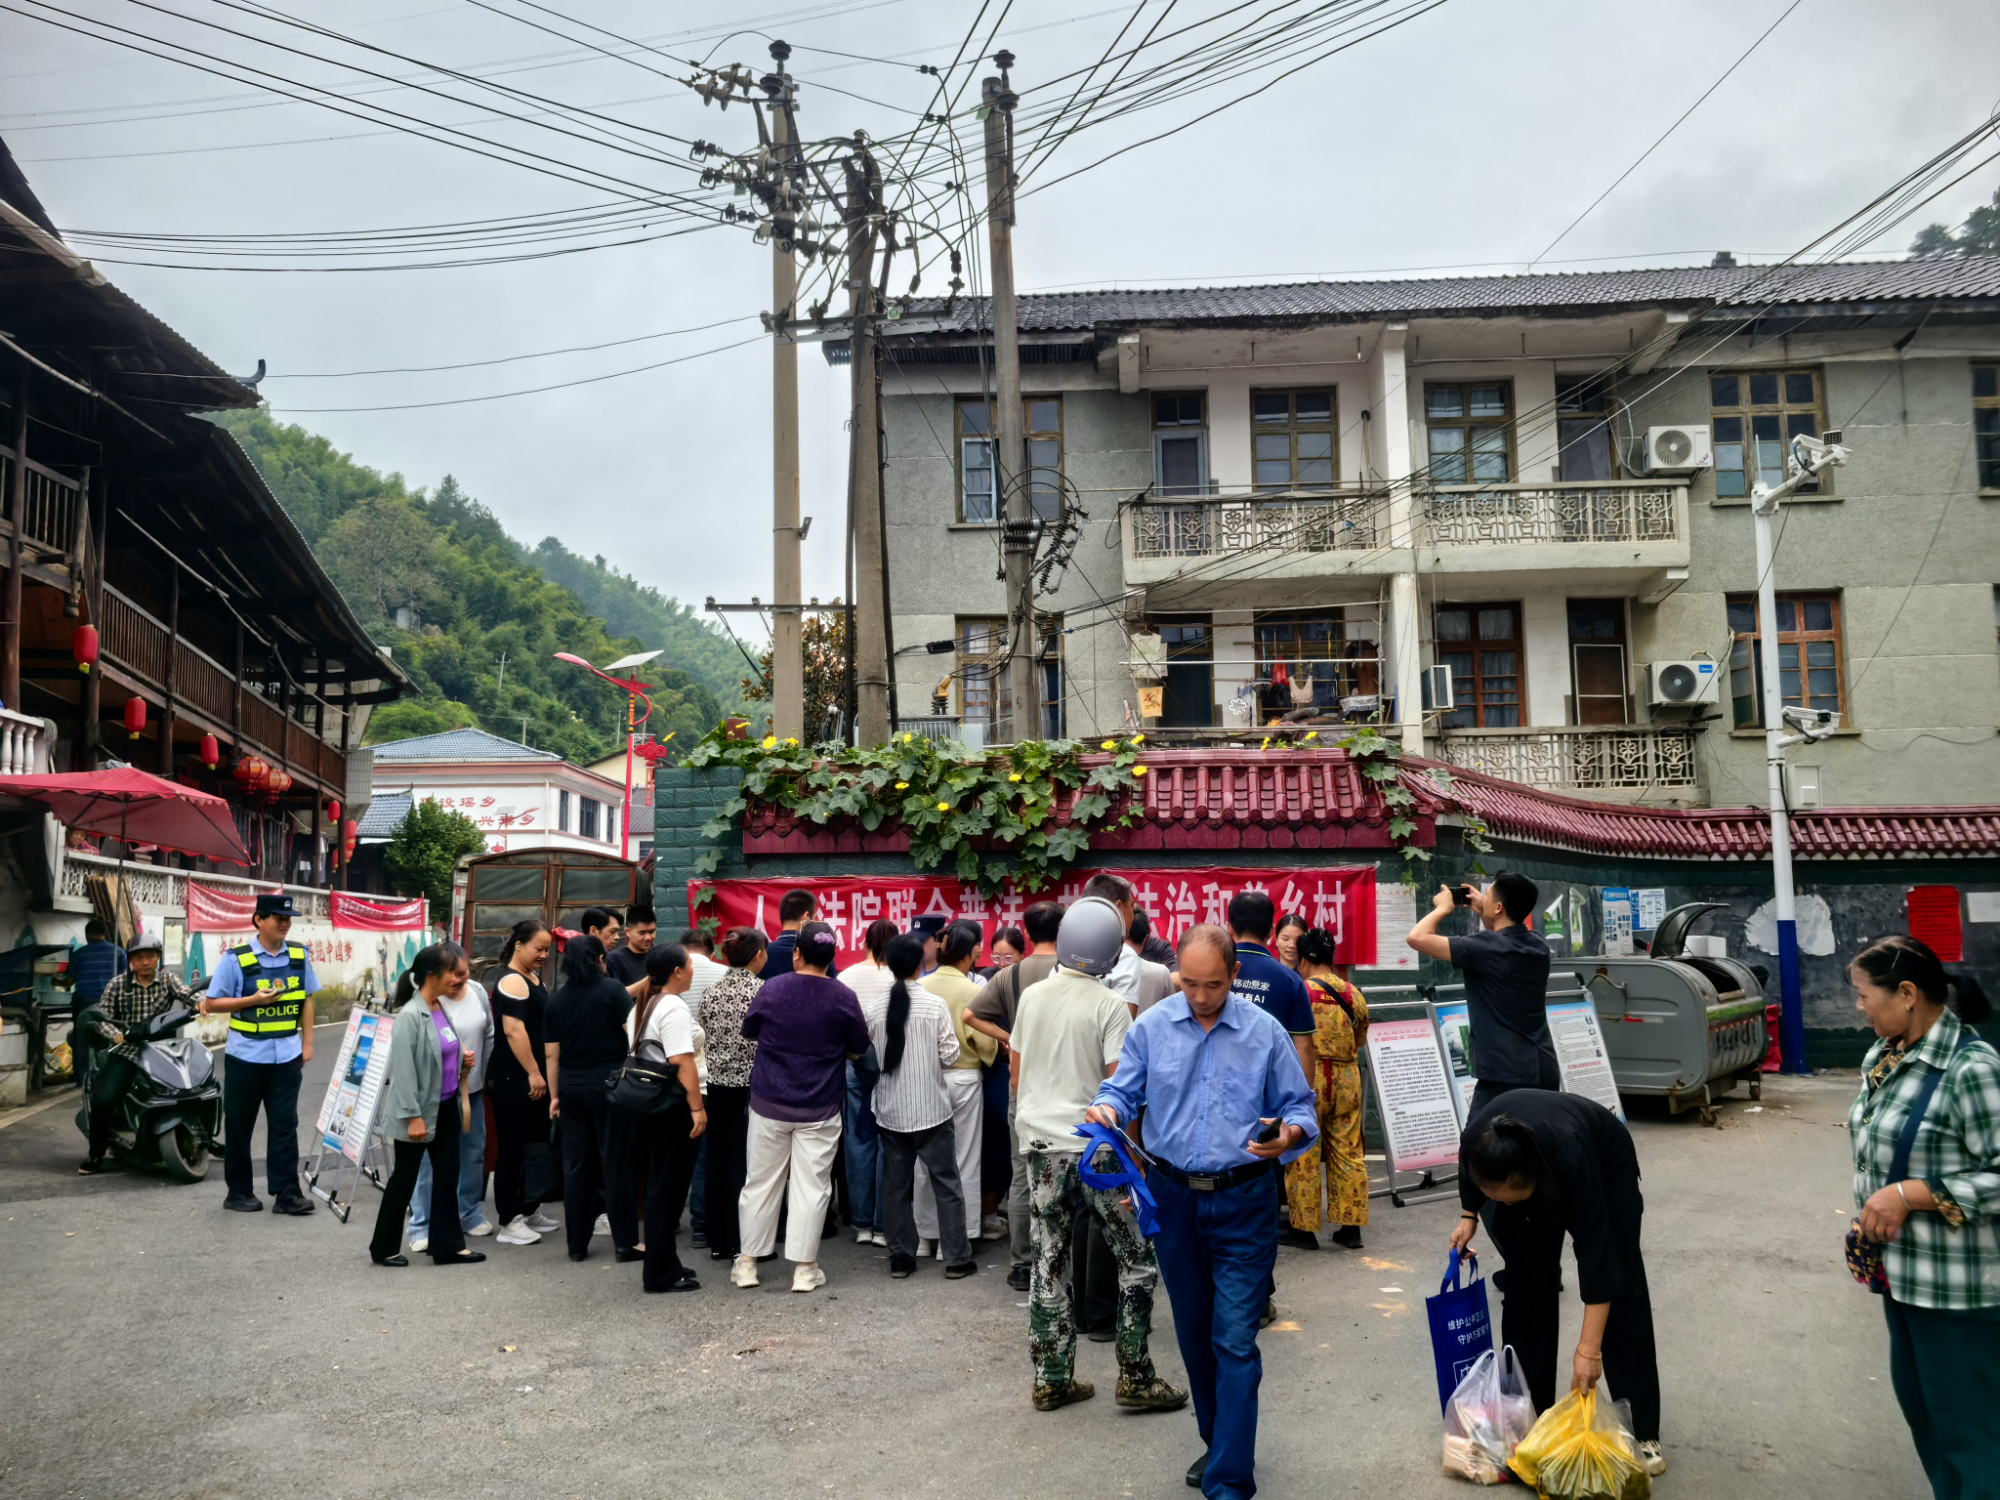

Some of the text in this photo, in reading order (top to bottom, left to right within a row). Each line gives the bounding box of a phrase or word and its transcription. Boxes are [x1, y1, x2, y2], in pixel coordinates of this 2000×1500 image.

[463, 813, 535, 827] 兴瑶乡
[754, 886, 1024, 951] 人法院联合普法
[256, 1004, 299, 1018] POLICE
